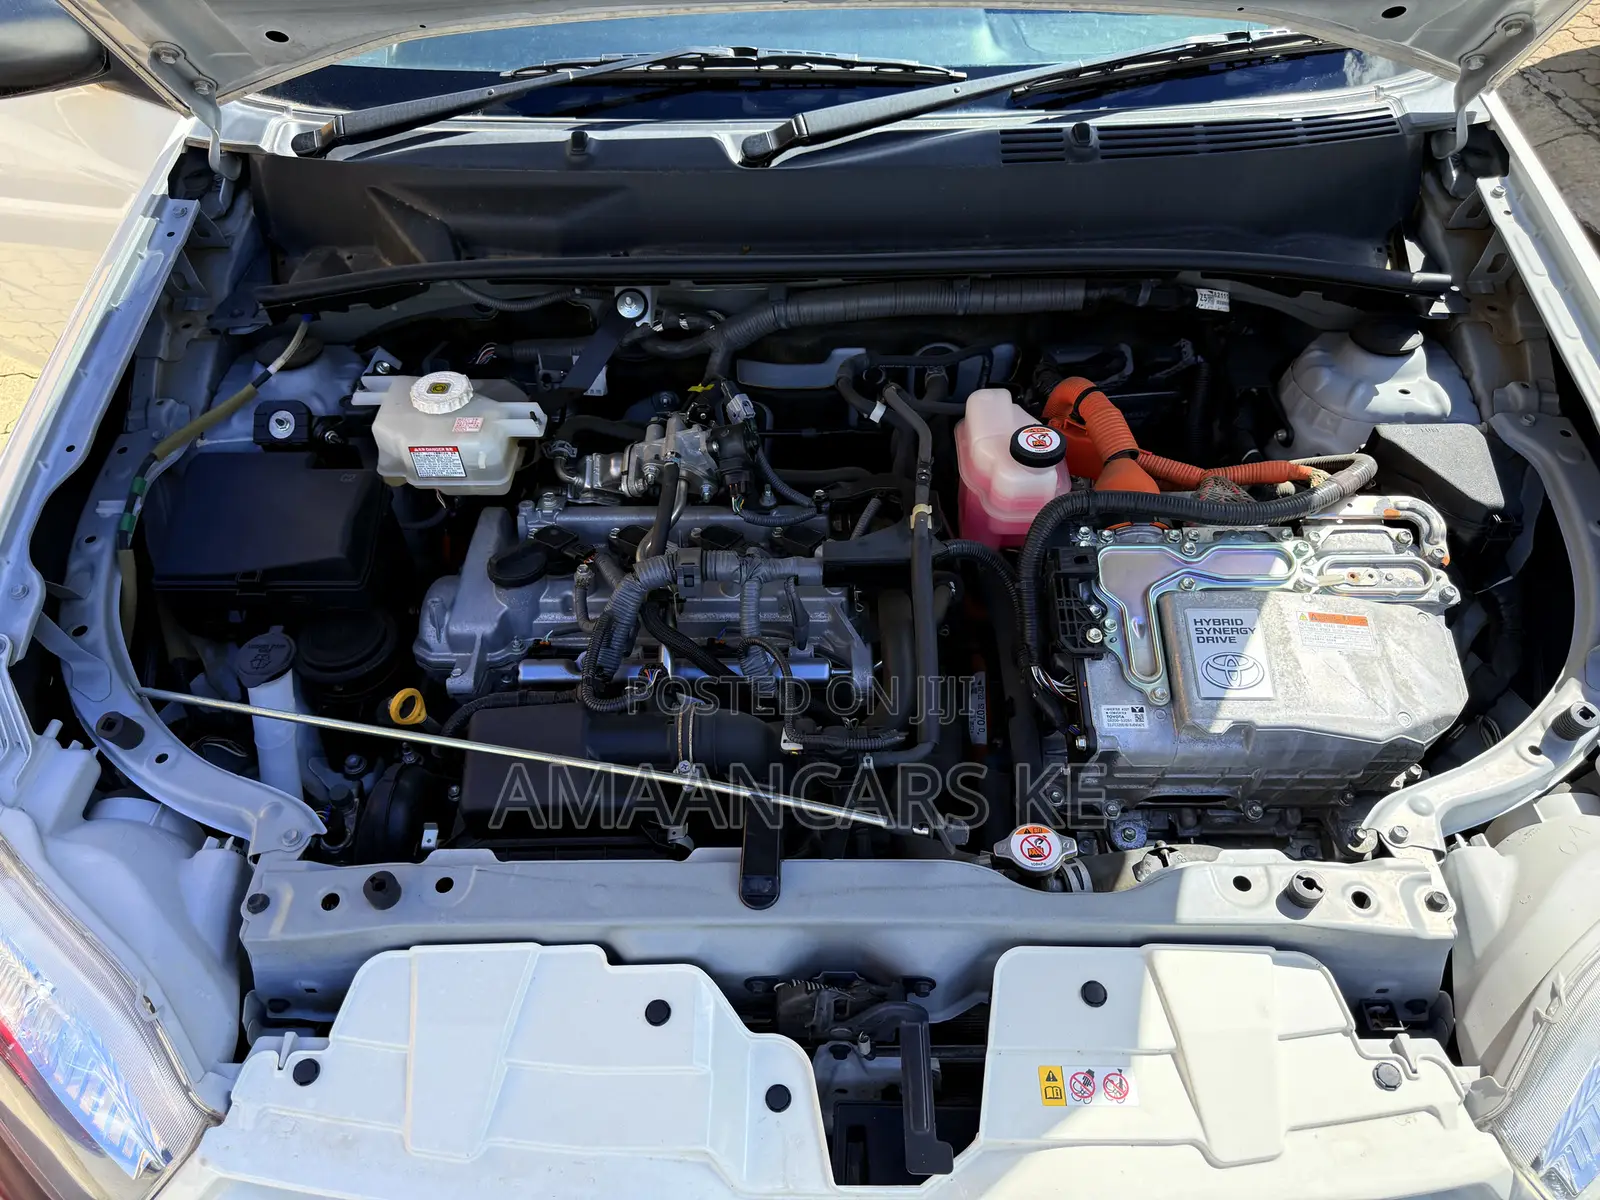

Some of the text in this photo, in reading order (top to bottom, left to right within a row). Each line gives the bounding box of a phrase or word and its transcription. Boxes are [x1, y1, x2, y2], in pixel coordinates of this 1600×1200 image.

[1193, 618, 1244, 626] HYBRID
[1194, 627, 1256, 635] SYNERGY
[1196, 636, 1238, 644] DRIVE
